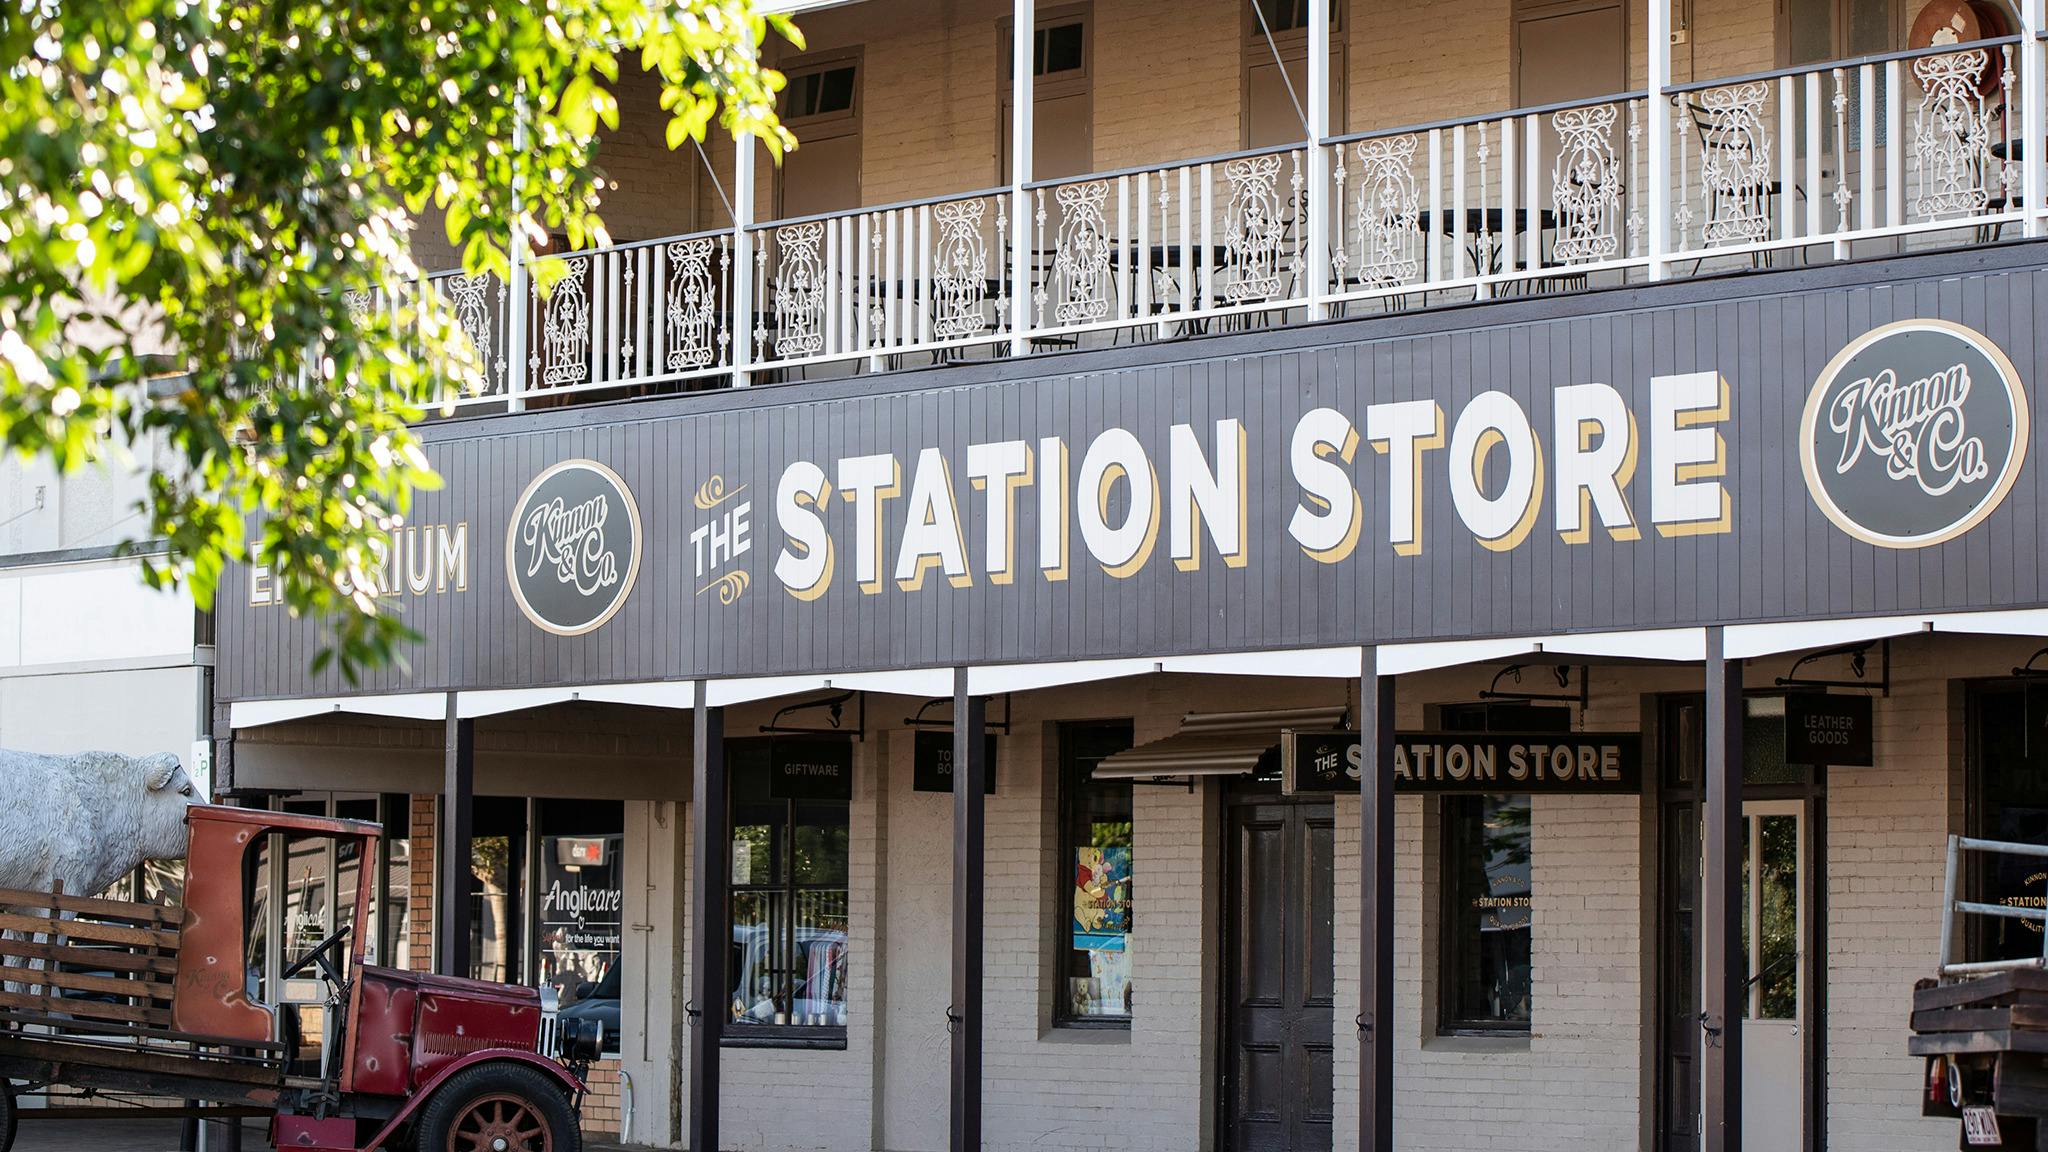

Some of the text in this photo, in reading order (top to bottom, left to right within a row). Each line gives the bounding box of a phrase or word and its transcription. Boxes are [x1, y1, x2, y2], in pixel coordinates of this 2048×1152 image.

[1829, 363, 1971, 474] Kinnon
[1887, 406, 1988, 496] & Co.
[690, 371, 1732, 601] THE STATION STORE
[524, 494, 608, 577] Kinnon
[557, 527, 617, 596] & Co.
[1804, 714, 1853, 729] LEATHER
[1809, 731, 1849, 744] GOODS
[784, 763, 839, 776] GIFTWARE
[1314, 744, 1621, 781] THE SATION STORE
[544, 880, 620, 918] Anglicare
[1478, 897, 1512, 907] STATION
[1513, 897, 1531, 907] STO
[2007, 896, 2046, 907] STATION
[565, 934, 574, 943] for
[574, 934, 584, 943] the
[584, 934, 593, 943] life
[593, 935, 604, 944] you
[605, 935, 620, 943] want
